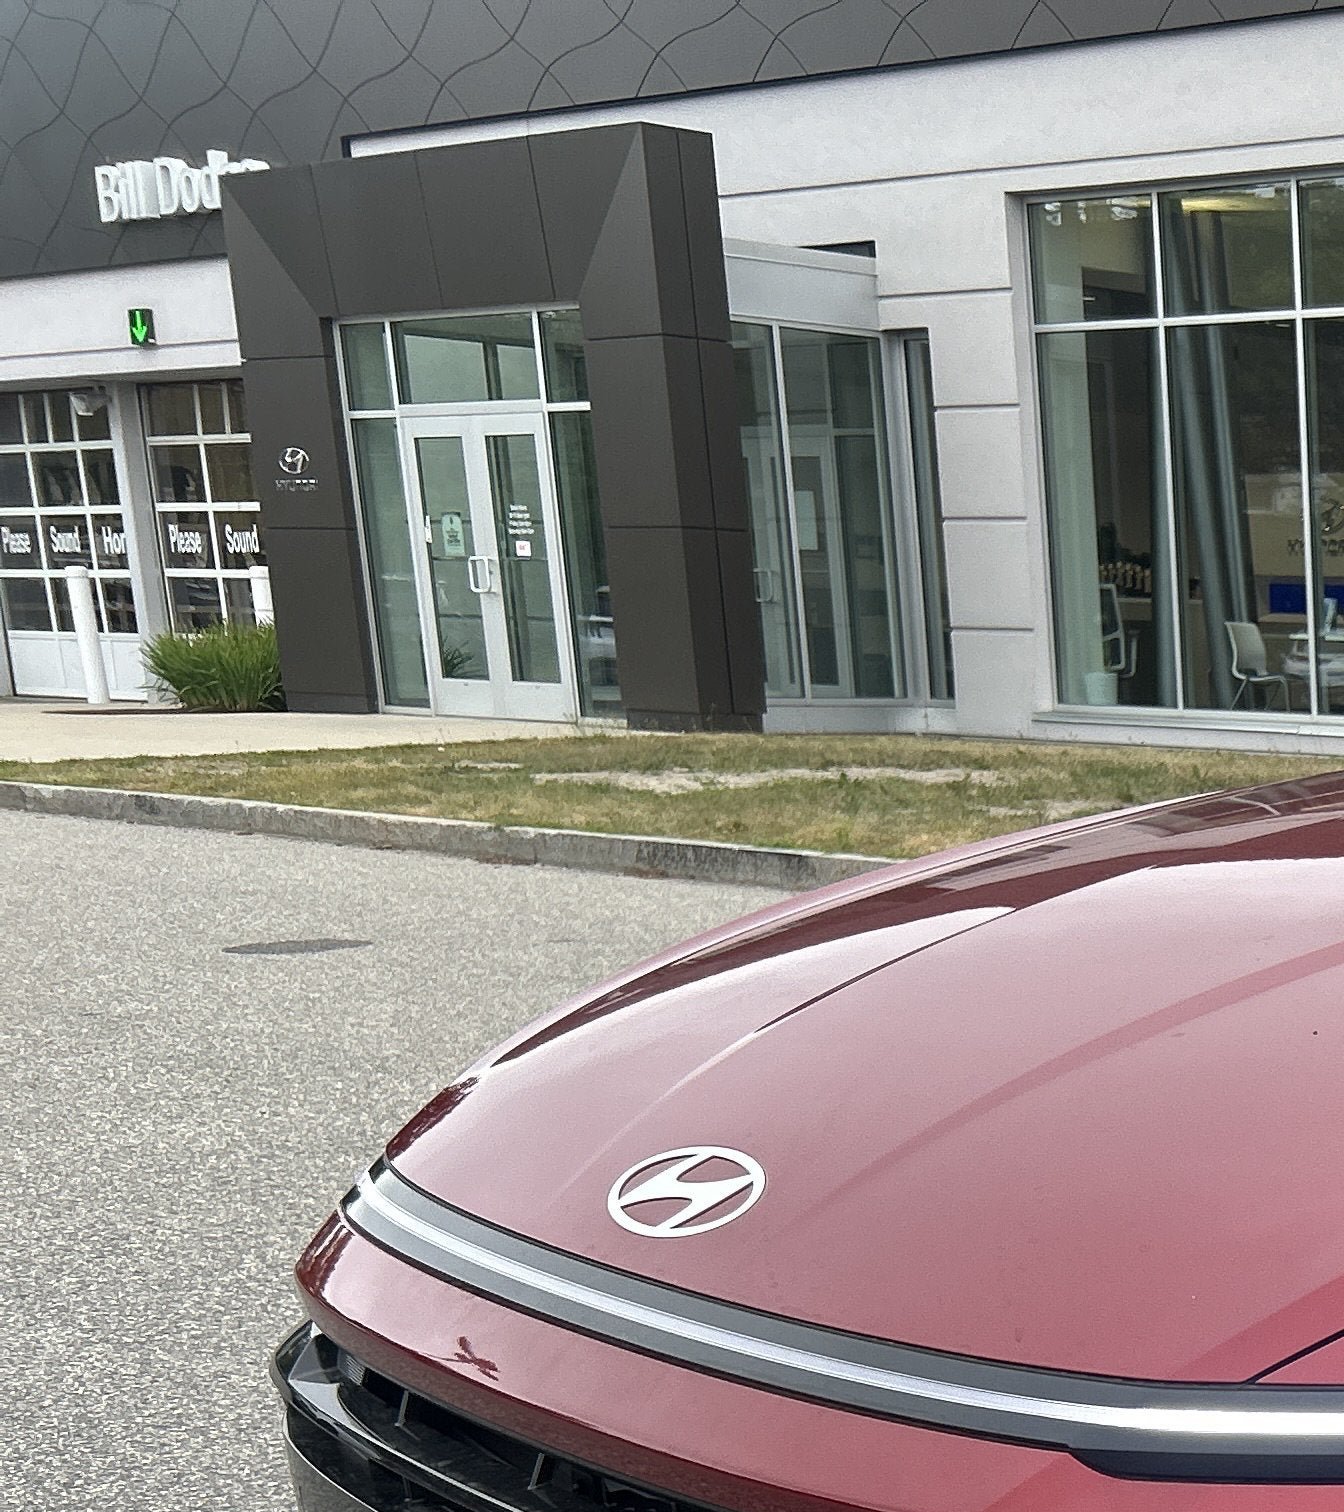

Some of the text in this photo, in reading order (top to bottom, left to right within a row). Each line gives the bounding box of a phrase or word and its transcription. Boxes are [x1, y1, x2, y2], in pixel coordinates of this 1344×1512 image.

[95, 149, 270, 223] Bill Dod
[49, 525, 81, 553] Sound
[167, 523, 260, 553] Please Sound
